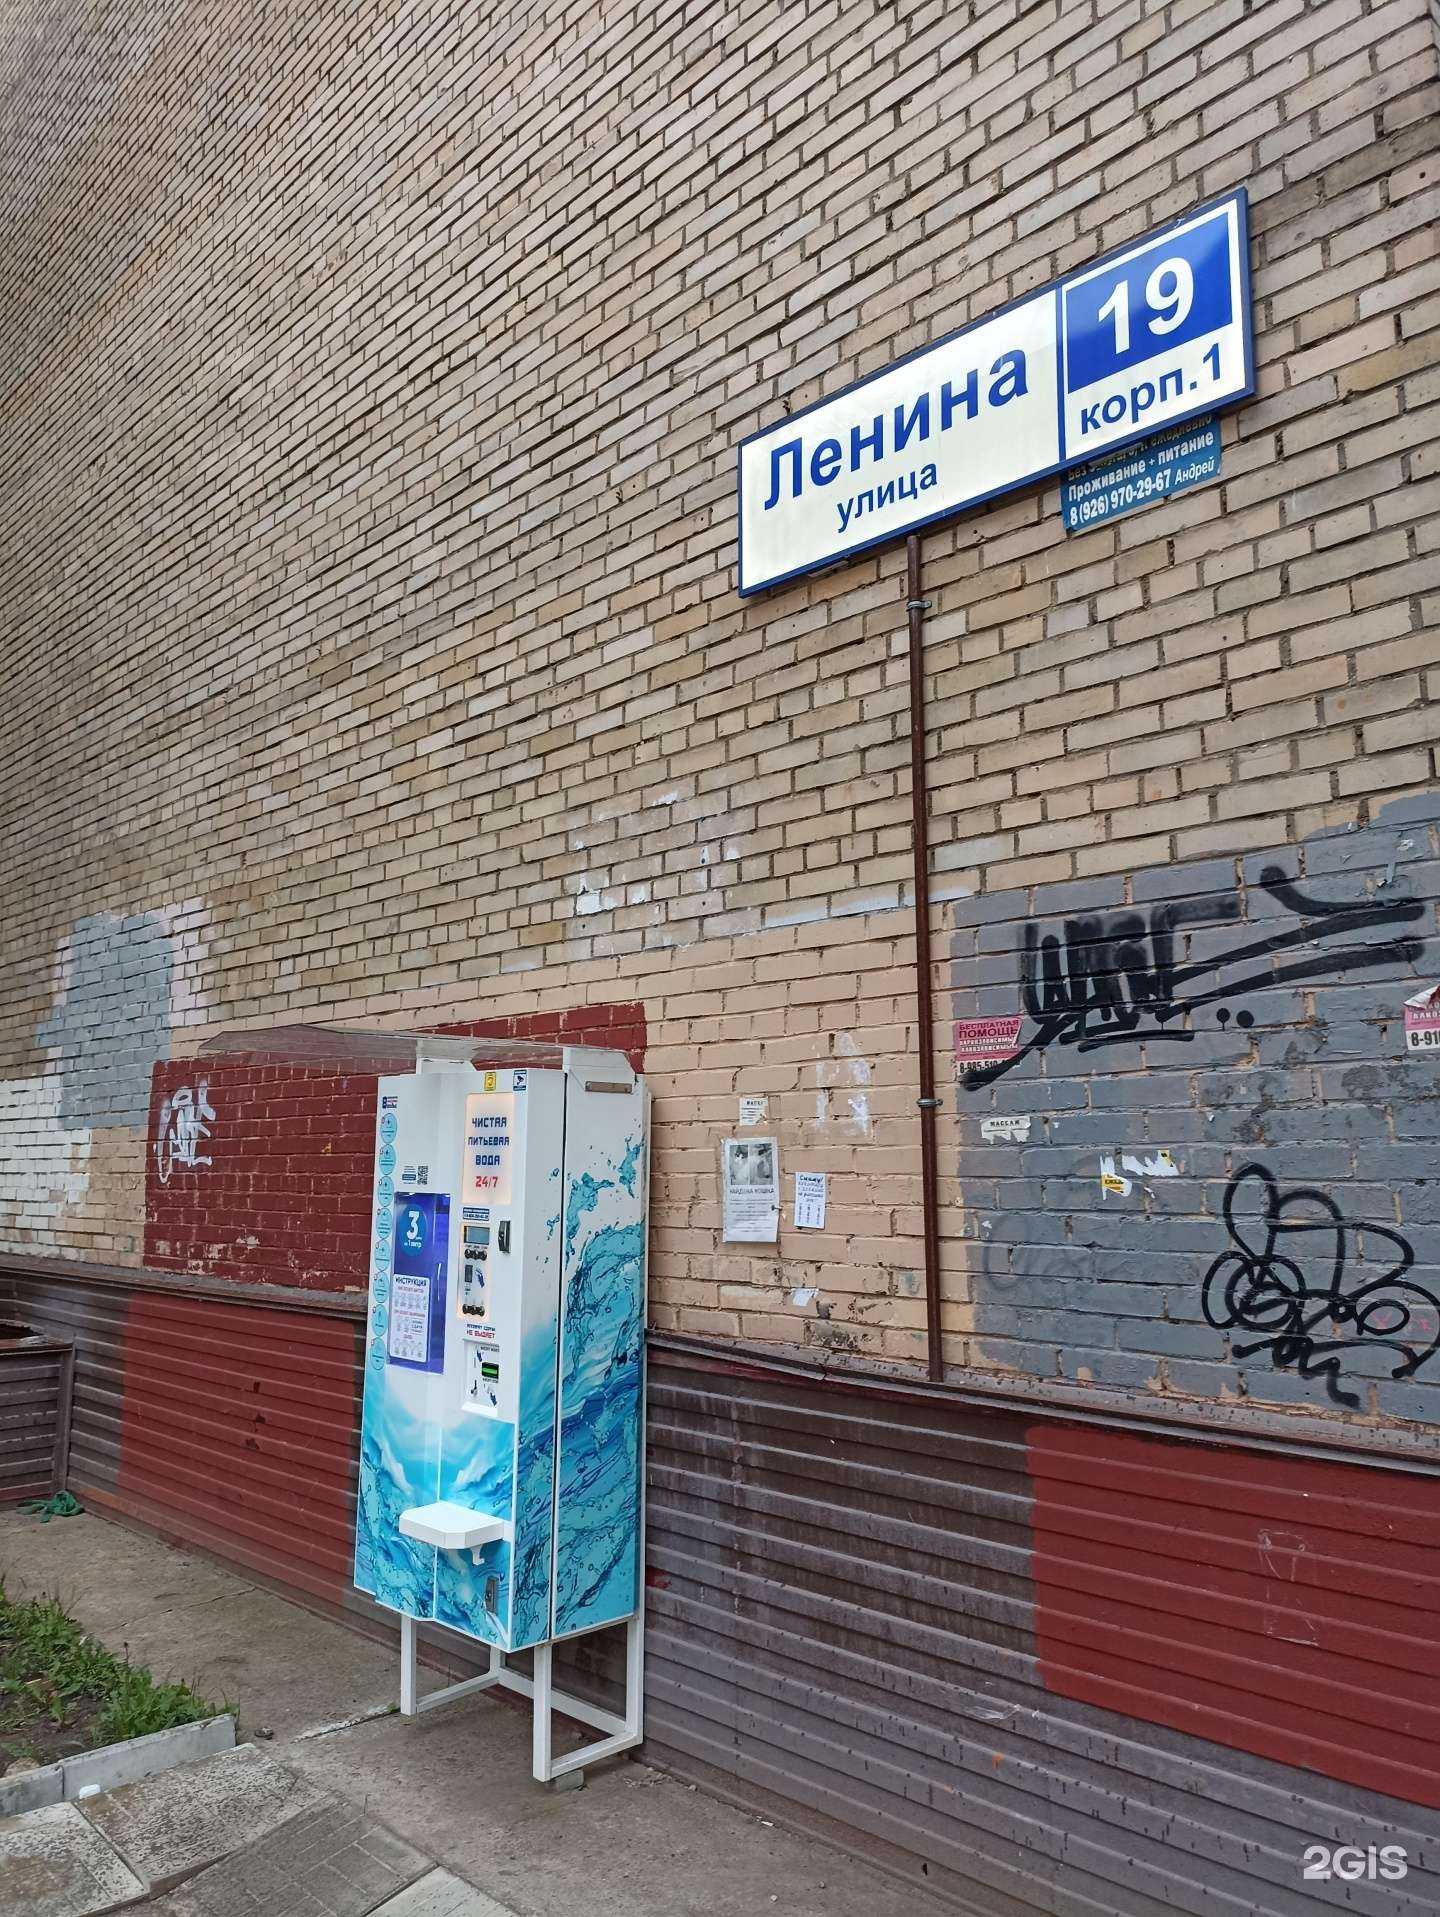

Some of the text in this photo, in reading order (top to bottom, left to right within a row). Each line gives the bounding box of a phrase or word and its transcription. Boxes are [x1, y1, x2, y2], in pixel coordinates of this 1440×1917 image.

[1097, 257, 1195, 355] 19
[764, 348, 1029, 510] Ленина
[1068, 459, 1145, 501] Проживание
[1158, 432, 1214, 465] питание
[1111, 469, 1171, 509] 970-29-67
[1174, 456, 1214, 485] Андрей
[837, 463, 938, 533] улица
[959, 1020, 1019, 1030] БЕСПЛАТНАЯ
[959, 1027, 1018, 1038] ПОМОЩЬ
[1411, 1030, 1440, 1047] 8-91
[472, 1117, 507, 1128] ЧИСТАЯ
[468, 1137, 510, 1146] ПИТЬЕВАЯ
[475, 1155, 500, 1166] ВОДА
[475, 1176, 498, 1188] 24/7
[406, 1211, 420, 1240] 3
